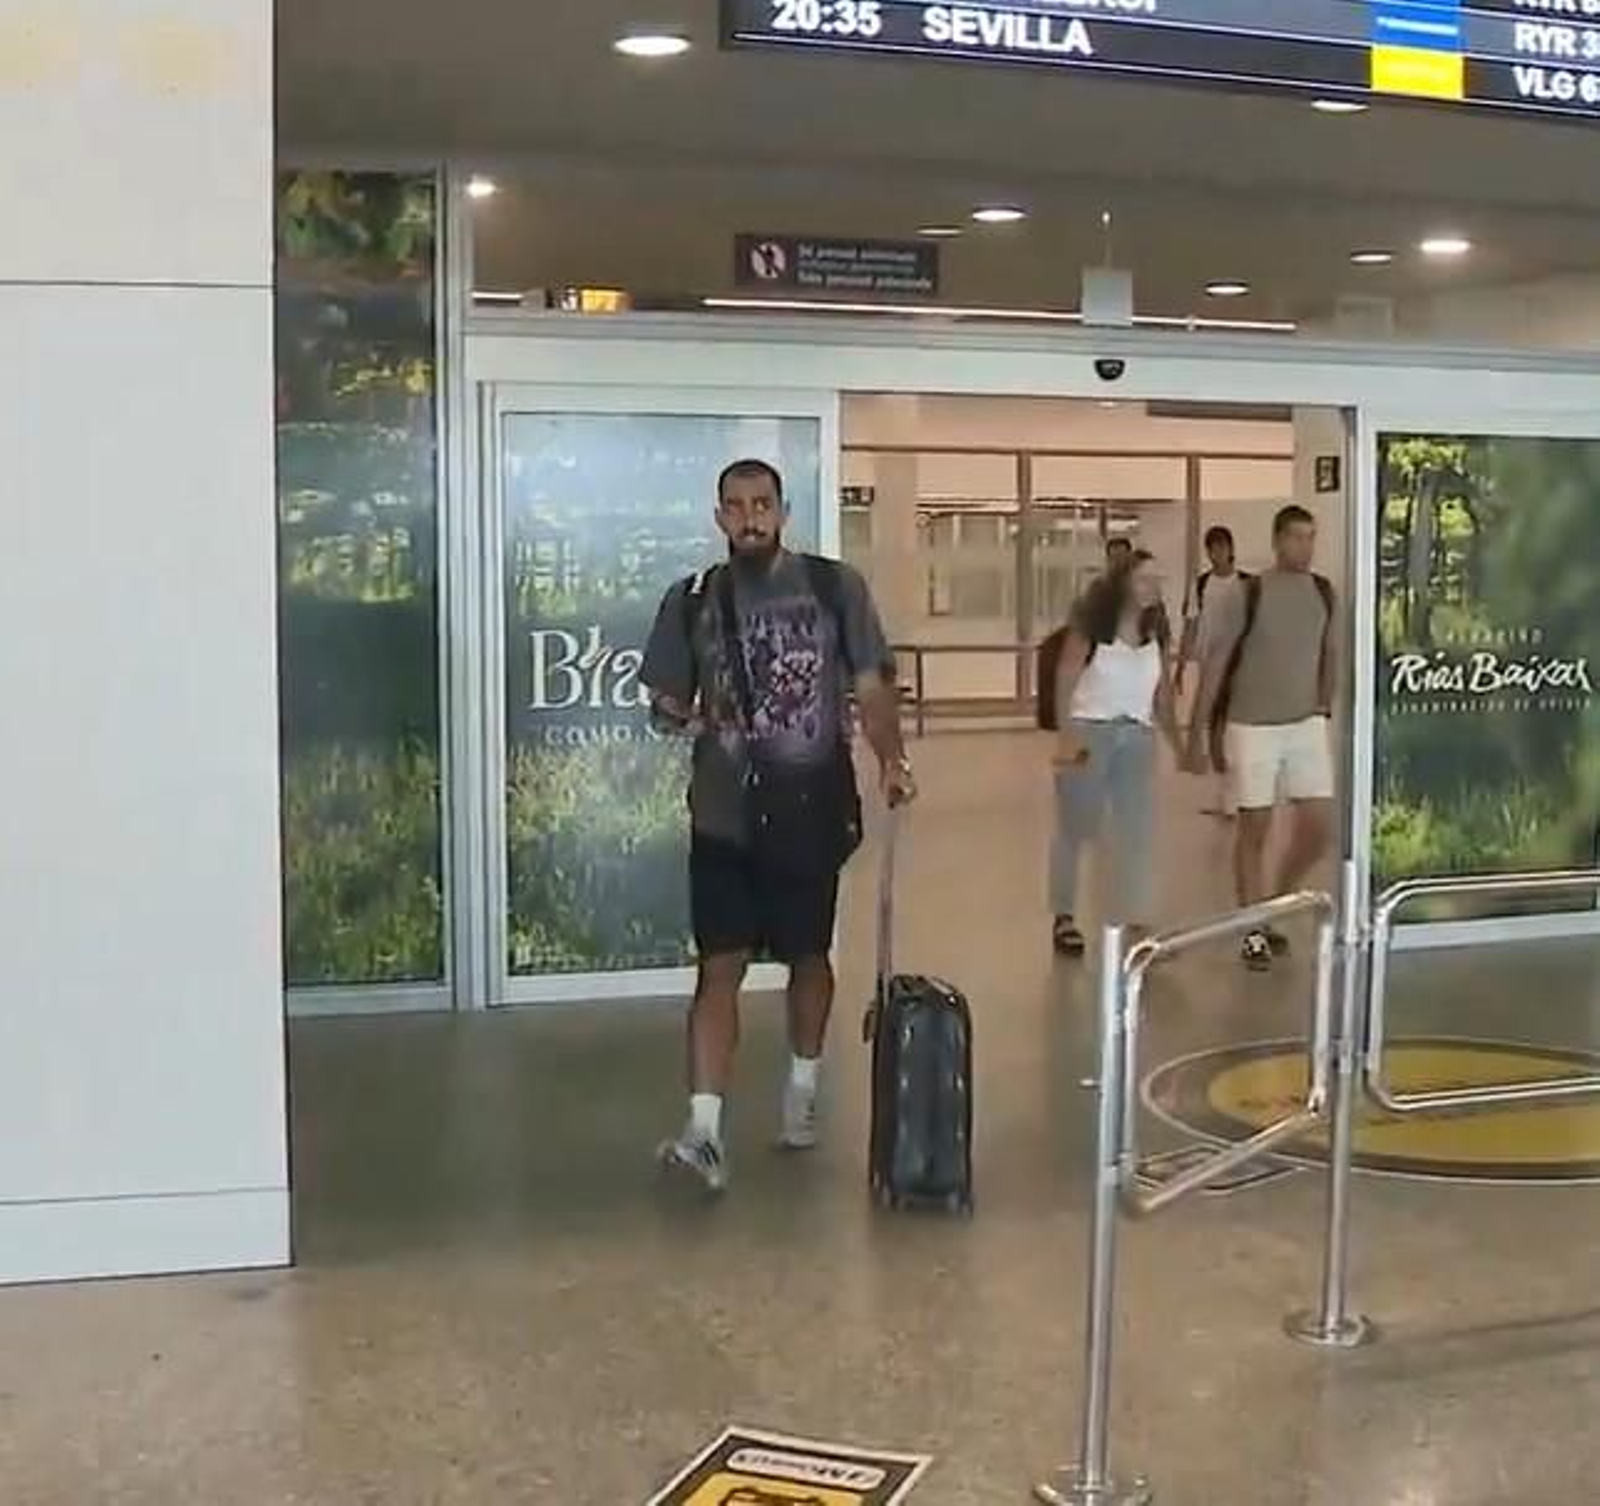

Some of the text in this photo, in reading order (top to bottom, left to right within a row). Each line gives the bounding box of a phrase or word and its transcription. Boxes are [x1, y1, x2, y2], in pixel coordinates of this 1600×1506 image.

[771, 0, 1093, 55] 20:35 SEVILLA
[1514, 22, 1576, 56] RYR
[1513, 66, 1576, 100] VLG
